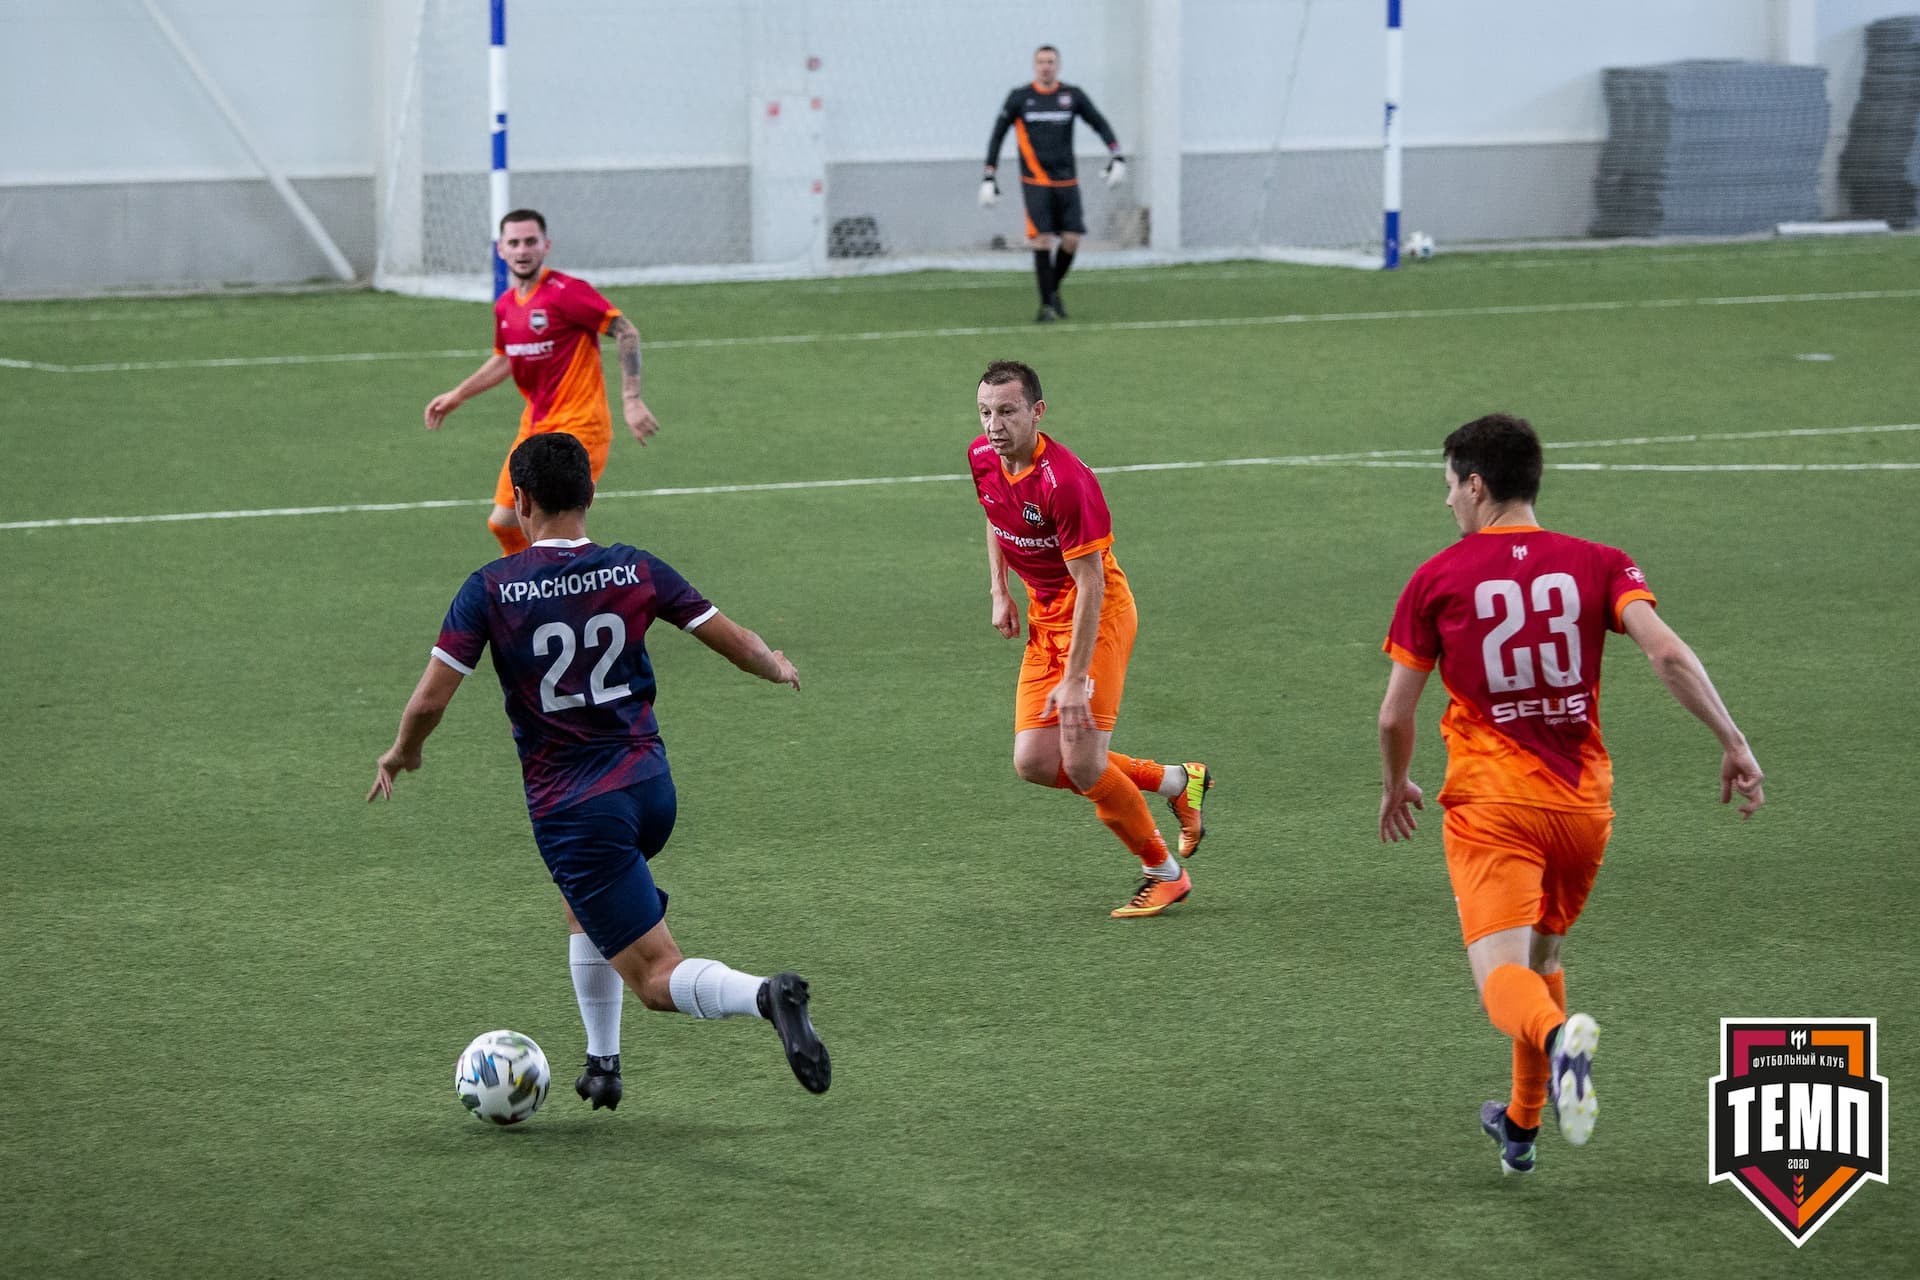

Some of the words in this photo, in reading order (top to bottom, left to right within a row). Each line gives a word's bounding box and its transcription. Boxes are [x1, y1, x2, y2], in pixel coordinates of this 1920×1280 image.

[499, 564, 640, 604] КРАСНОЯРСК
[1474, 572, 1582, 694] 23
[532, 612, 633, 713] 22
[1491, 693, 1589, 724] SEUS
[1186, 764, 1206, 811] NIKE
